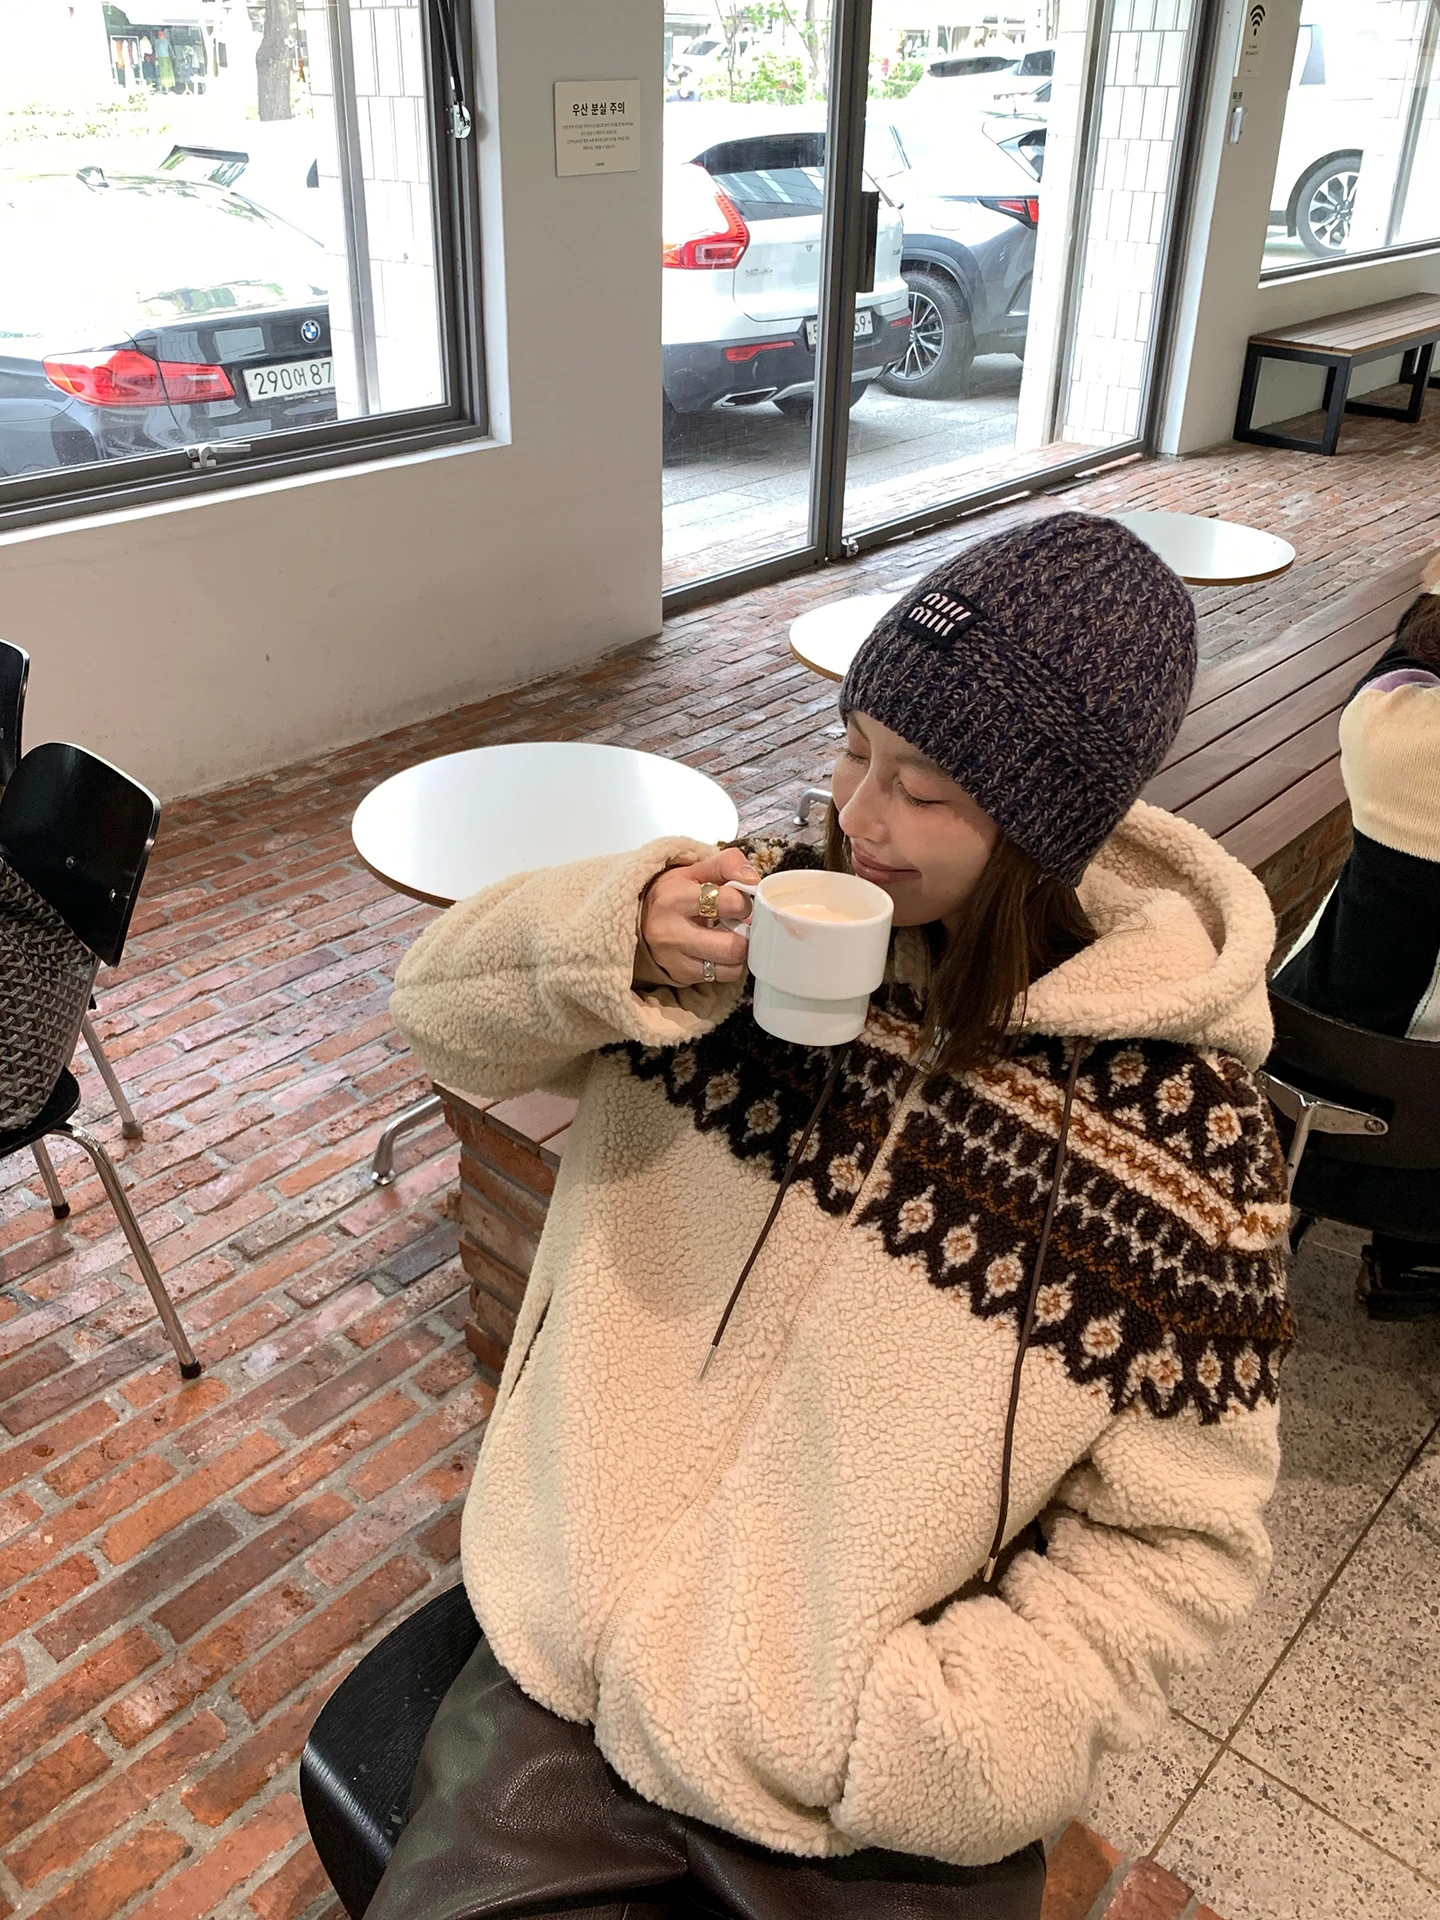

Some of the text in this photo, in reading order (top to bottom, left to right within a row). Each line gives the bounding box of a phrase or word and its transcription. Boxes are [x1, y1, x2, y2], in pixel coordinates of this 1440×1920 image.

[572, 101, 625, 116] 우산 분실 주의
